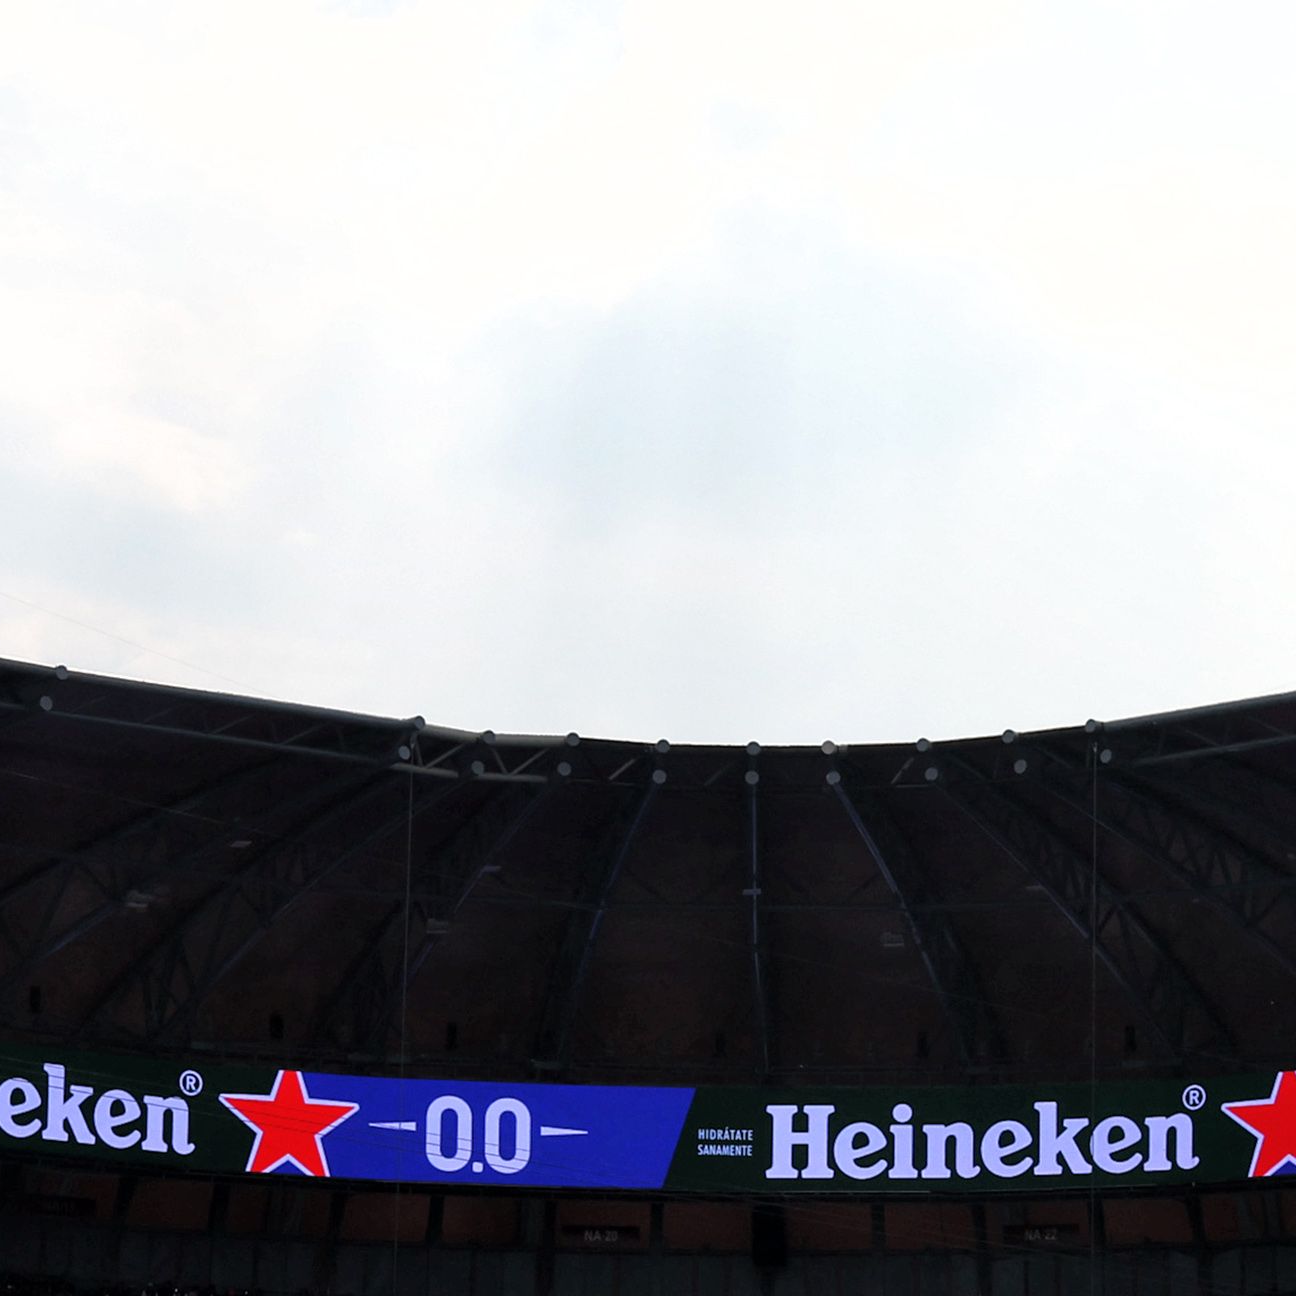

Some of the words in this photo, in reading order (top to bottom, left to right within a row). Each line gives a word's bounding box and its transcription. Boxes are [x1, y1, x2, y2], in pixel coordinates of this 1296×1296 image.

[425, 1095, 531, 1174] 0.0
[698, 1126, 754, 1141] HIDRÁTATE
[697, 1144, 753, 1156] SANAMENTE
